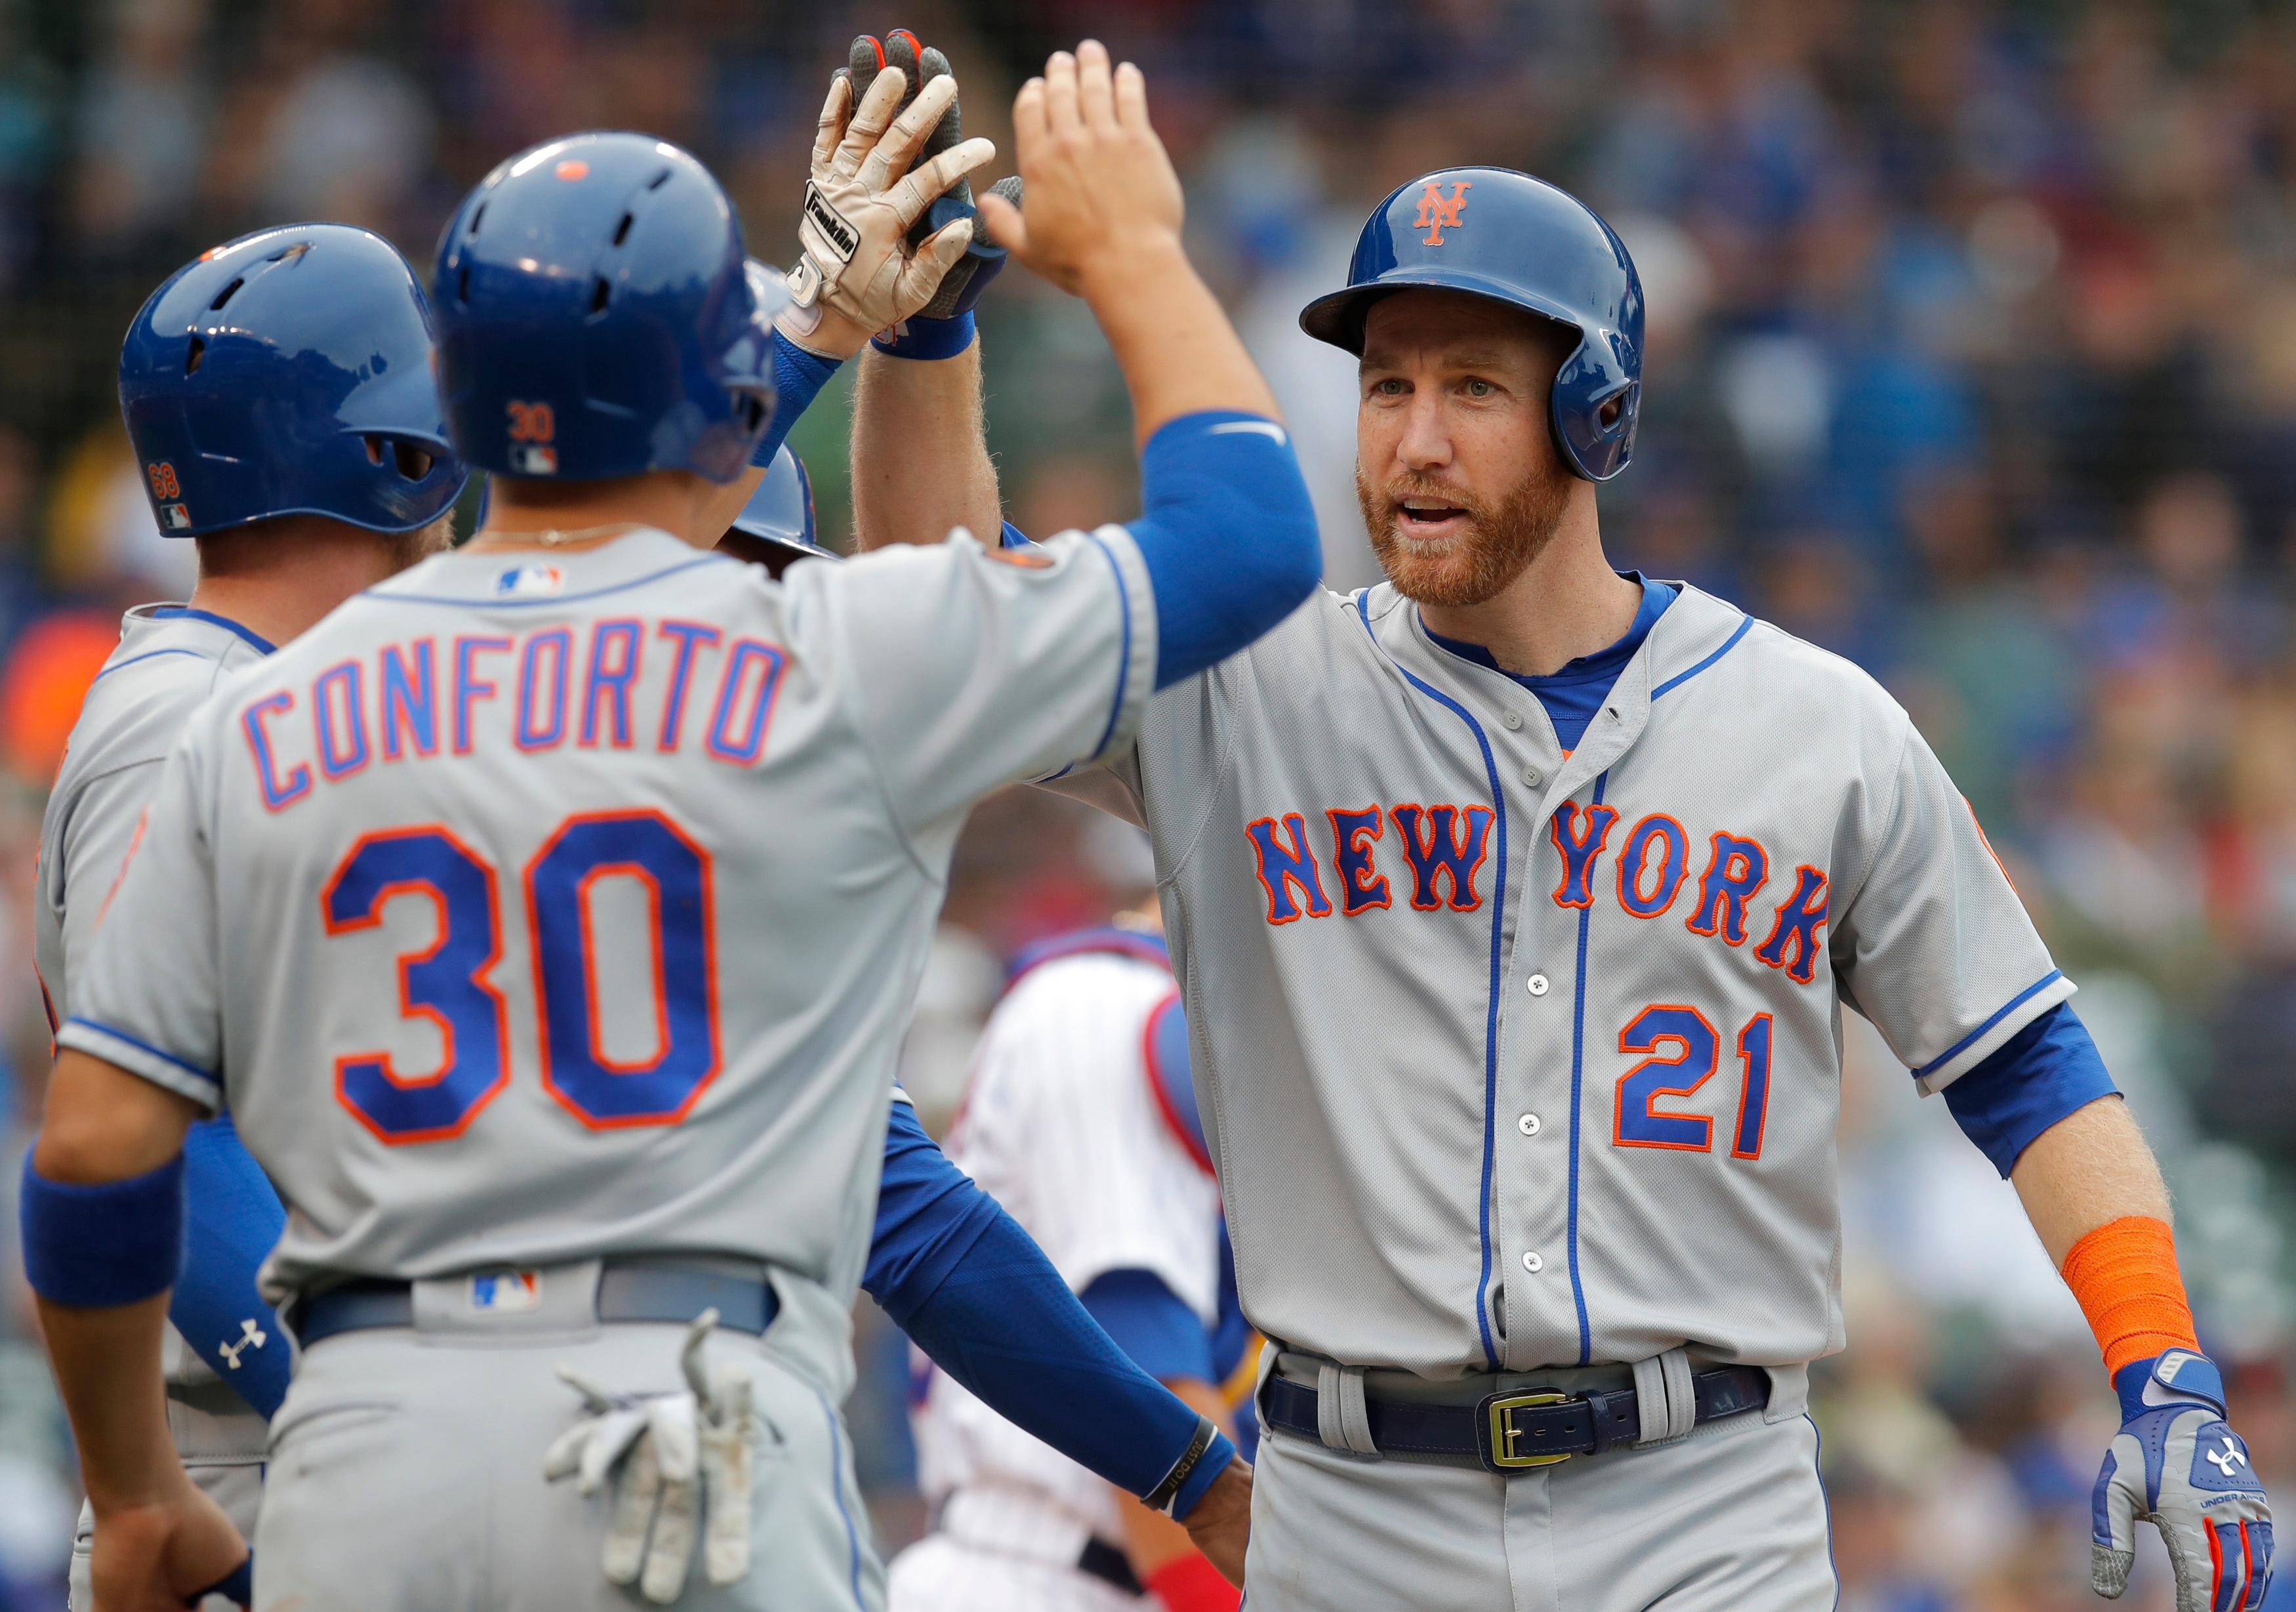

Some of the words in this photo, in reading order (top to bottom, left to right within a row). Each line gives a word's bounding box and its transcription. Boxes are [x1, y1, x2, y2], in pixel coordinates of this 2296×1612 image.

[806, 190, 855, 255] Franklin
[506, 399, 554, 442] 30
[148, 462, 180, 499] 68
[241, 616, 790, 814] CONFORTO
[1245, 802, 1496, 926] NEW
[1550, 800, 1830, 985] YORK
[319, 808, 724, 1147] 30
[1612, 1003, 1773, 1161] 21
[1176, 1462, 1191, 1479] DO
[1187, 1441, 1204, 1464] JUST
[2200, 1493, 2238, 1508] UNDER
